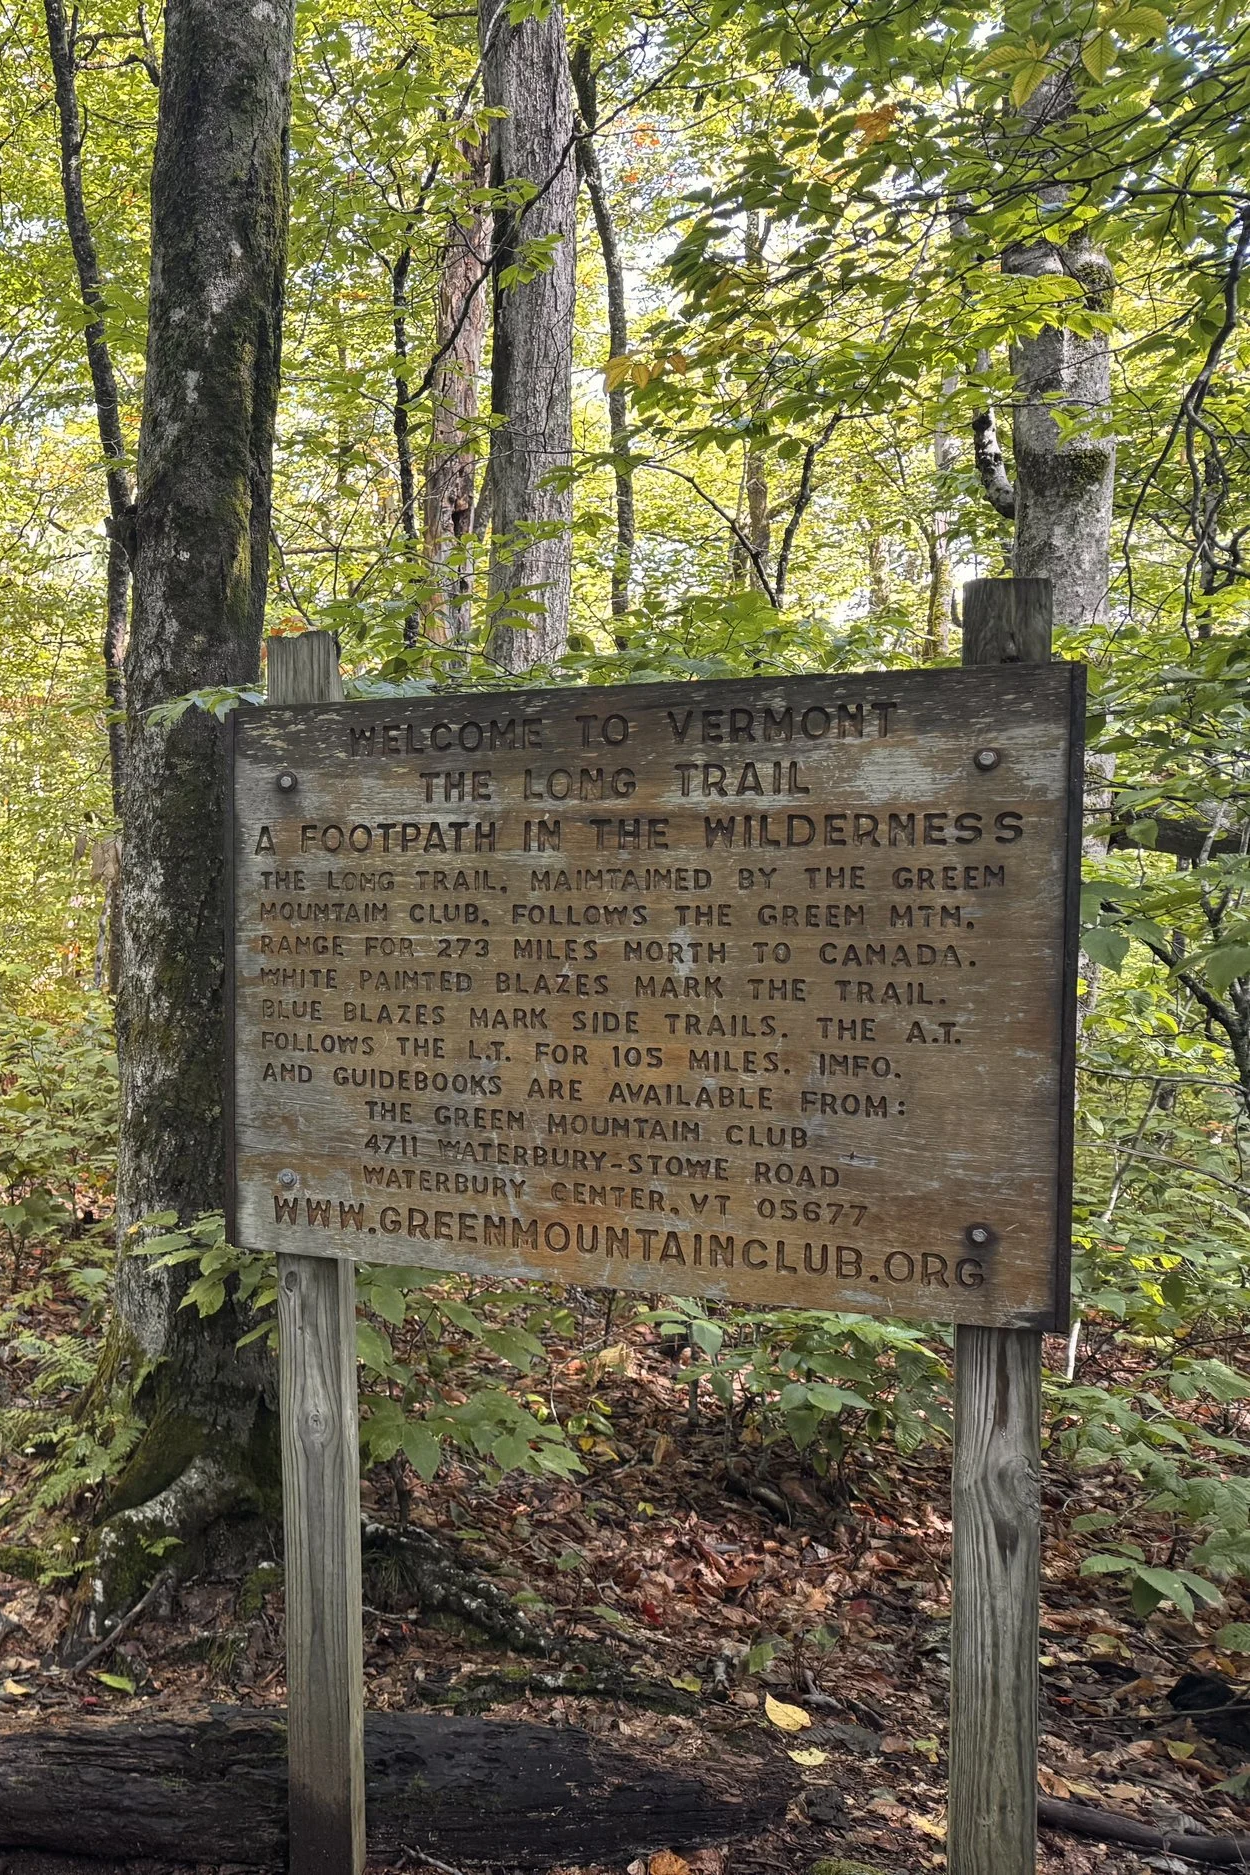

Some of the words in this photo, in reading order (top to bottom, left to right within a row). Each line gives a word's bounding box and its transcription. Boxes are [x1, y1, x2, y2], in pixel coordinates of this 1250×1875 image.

[350, 718, 543, 757] WELCOME
[575, 714, 630, 748] TO
[667, 702, 897, 744] VERMONT
[419, 770, 492, 802] THE
[524, 767, 637, 802] LONG
[674, 761, 810, 798] TRAIL
[254, 825, 276, 856] A
[301, 821, 496, 853] FOOTPATH
[523, 819, 561, 852] IN
[589, 818, 669, 851] THE
[704, 811, 1024, 848] WILDERNESS
[261, 871, 306, 891] THE
[327, 871, 395, 892] LONG
[531, 868, 712, 892] MAINTAINED
[738, 867, 777, 890] BY
[804, 866, 866, 889] THE
[892, 865, 1005, 891] GREEN
[260, 902, 389, 923] MOUNTAIN
[512, 904, 648, 926] FOLLOWS
[674, 903, 732, 927] THE
[757, 904, 864, 928] GREEN
[260, 935, 345, 956] RANGE
[365, 936, 415, 957] FOR
[437, 938, 489, 958] 273
[513, 938, 598, 961] MILES
[623, 940, 726, 964] NORTH
[752, 942, 791, 964] TO
[819, 942, 976, 968] CANADA.
[260, 967, 338, 990] WHITE
[359, 969, 473, 992] PAINTED
[495, 972, 608, 996] BLAZES
[635, 975, 723, 999] MARK
[747, 978, 807, 1002] THE
[834, 980, 947, 1006] TRAIL.
[261, 999, 323, 1021] BLUE
[343, 1001, 446, 1025] BLAZES
[469, 1007, 548, 1030] MARK
[572, 1010, 639, 1034] SIDE
[664, 1013, 788, 1038] TRAILS.
[816, 1017, 876, 1042] THE
[906, 1021, 962, 1044] A.T.
[261, 1031, 375, 1055] FOLLOWS
[396, 1036, 446, 1060] THE
[535, 1042, 589, 1066] FOR
[612, 1045, 663, 1069] 105
[688, 1049, 791, 1075] MILES.
[819, 1053, 902, 1079] INFO.
[262, 1062, 313, 1083] AND
[333, 1066, 502, 1096] GUIDEBOOKS
[527, 1078, 583, 1101] ARE
[609, 1081, 773, 1111] AVAILABLE
[800, 1090, 906, 1119] FROM:
[364, 1100, 413, 1124] THE
[434, 1105, 525, 1131] GREEN
[548, 1113, 700, 1142] MOUNTAIN
[725, 1124, 808, 1149] CLUB
[364, 1134, 418, 1157] 4711
[438, 1138, 729, 1181] WATERBURY-STOWE
[754, 1161, 840, 1188] ROAD
[363, 1165, 527, 1199] WATERBURY
[757, 1197, 869, 1227] 05677
[274, 1195, 985, 1290] WWW.GREENMOUNTAINCLUB.ORG
